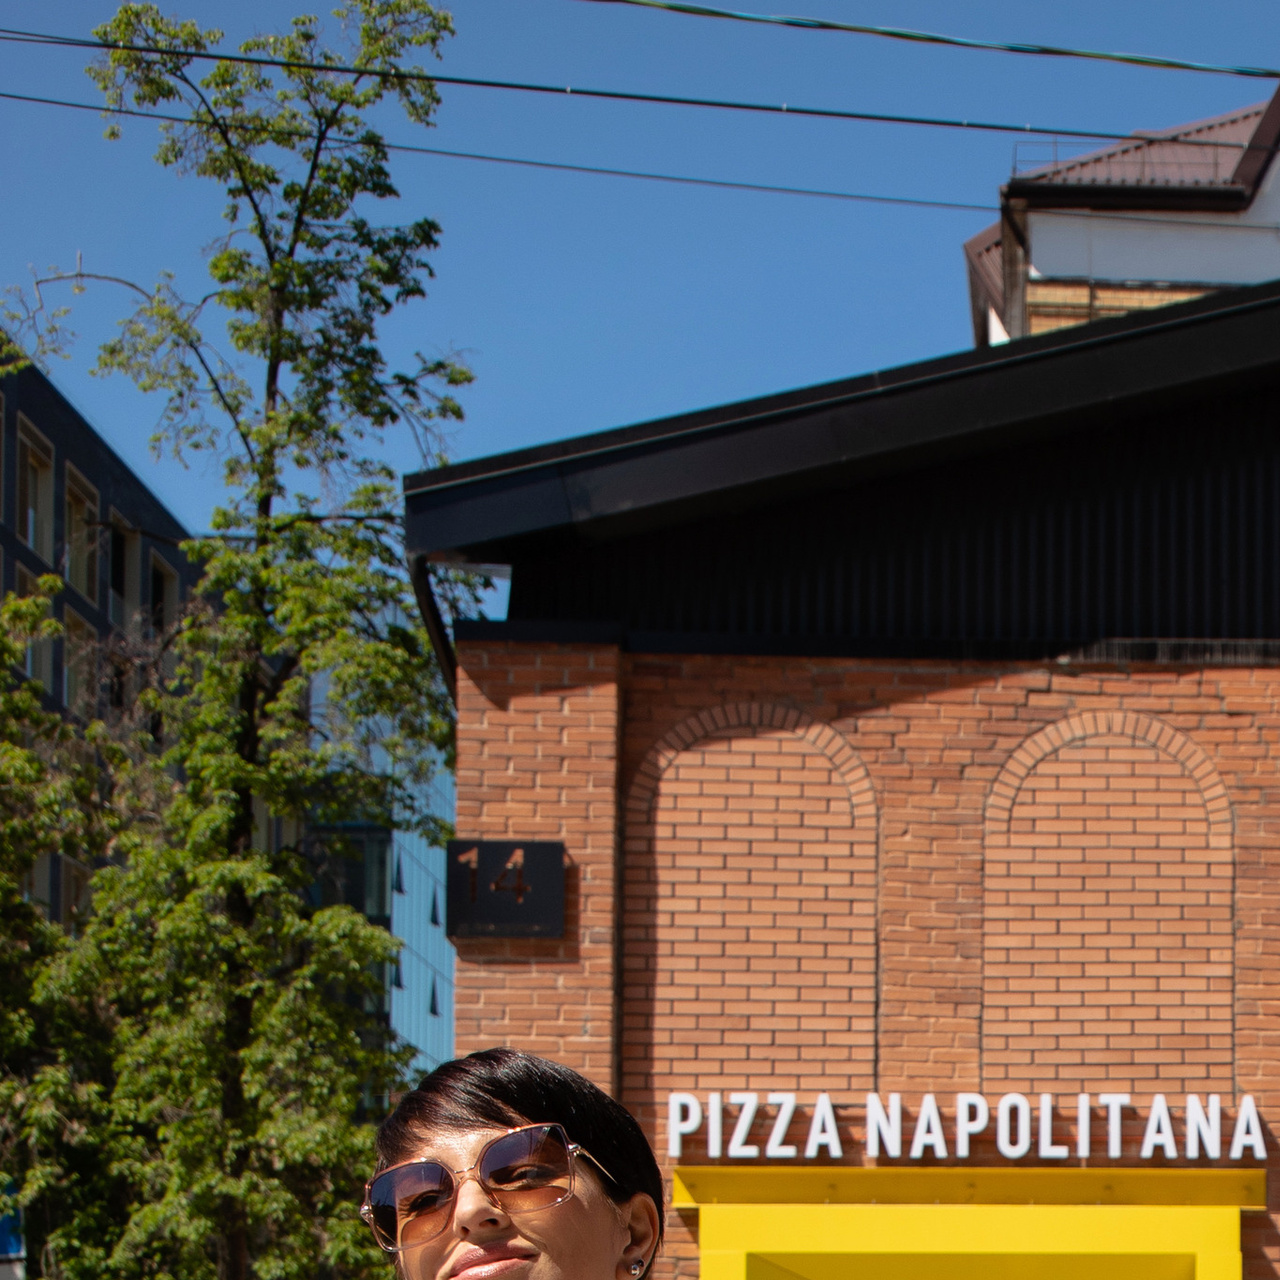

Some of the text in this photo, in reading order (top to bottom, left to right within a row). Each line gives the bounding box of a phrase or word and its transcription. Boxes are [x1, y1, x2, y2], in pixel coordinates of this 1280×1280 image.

[456, 847, 532, 904] 14
[668, 1092, 1268, 1160] PIZZA NAPOLITANA
